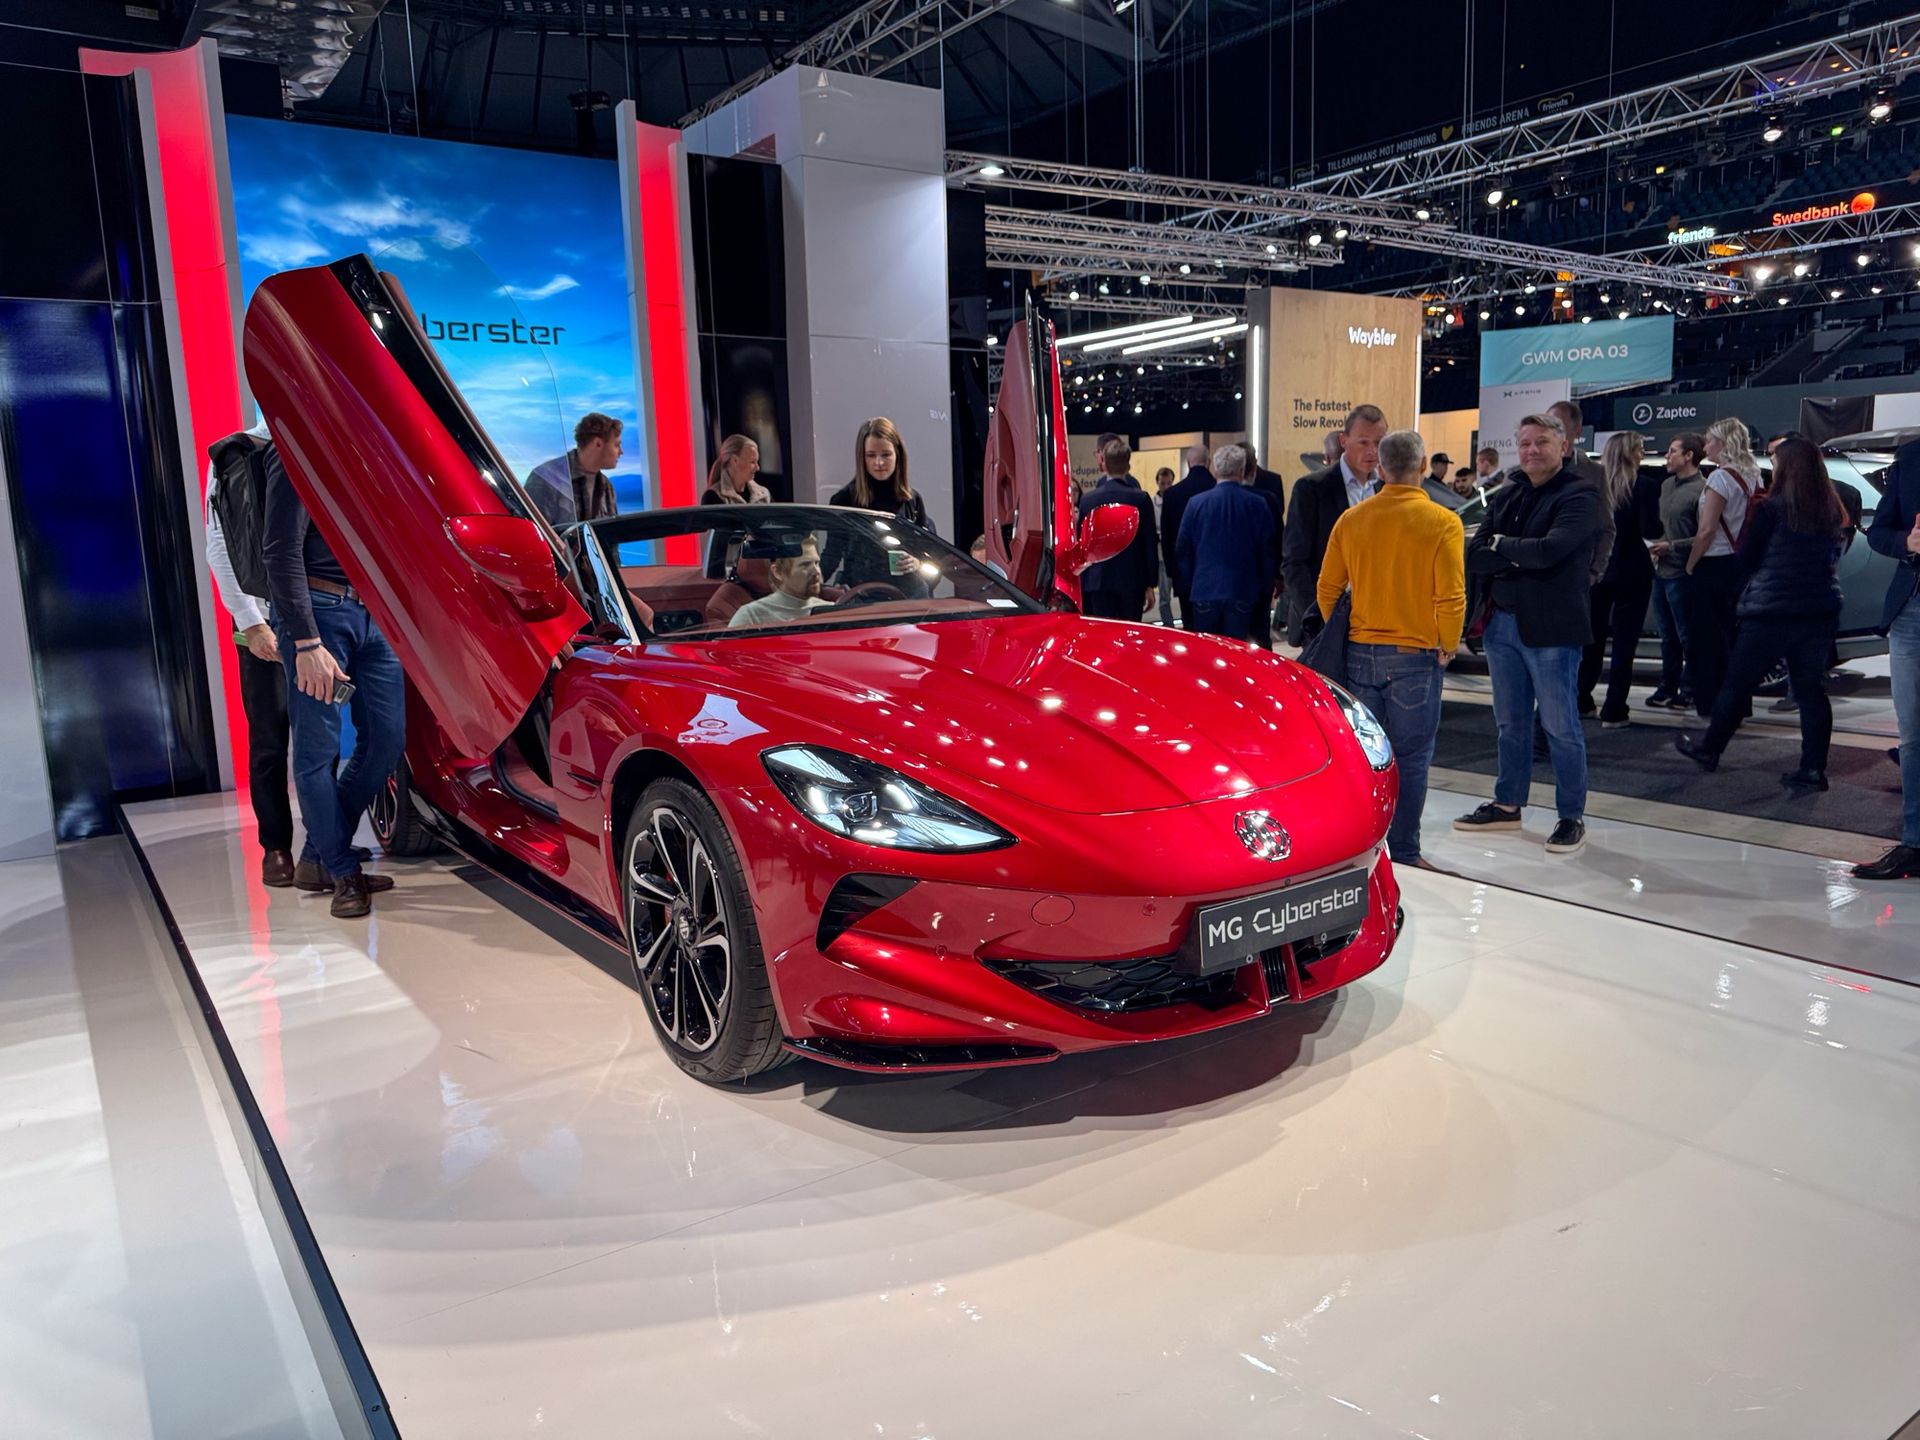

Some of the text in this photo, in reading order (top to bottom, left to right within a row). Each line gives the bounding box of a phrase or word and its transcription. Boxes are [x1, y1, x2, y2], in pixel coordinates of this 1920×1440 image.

[1327, 107, 1530, 171] TILLSAMMANS MOT MOBBNING FRIENDS ARENA
[1773, 201, 1849, 226] Swedbank
[1667, 226, 1715, 245] friends
[1349, 326, 1397, 348] Waybler
[1521, 344, 1629, 366] GWM ORA 03
[1293, 398, 1351, 412] The Fastest
[1656, 406, 1697, 420] Zaptec
[1293, 415, 1317, 428] Slow
[1208, 886, 1363, 947] MG Cyberster
